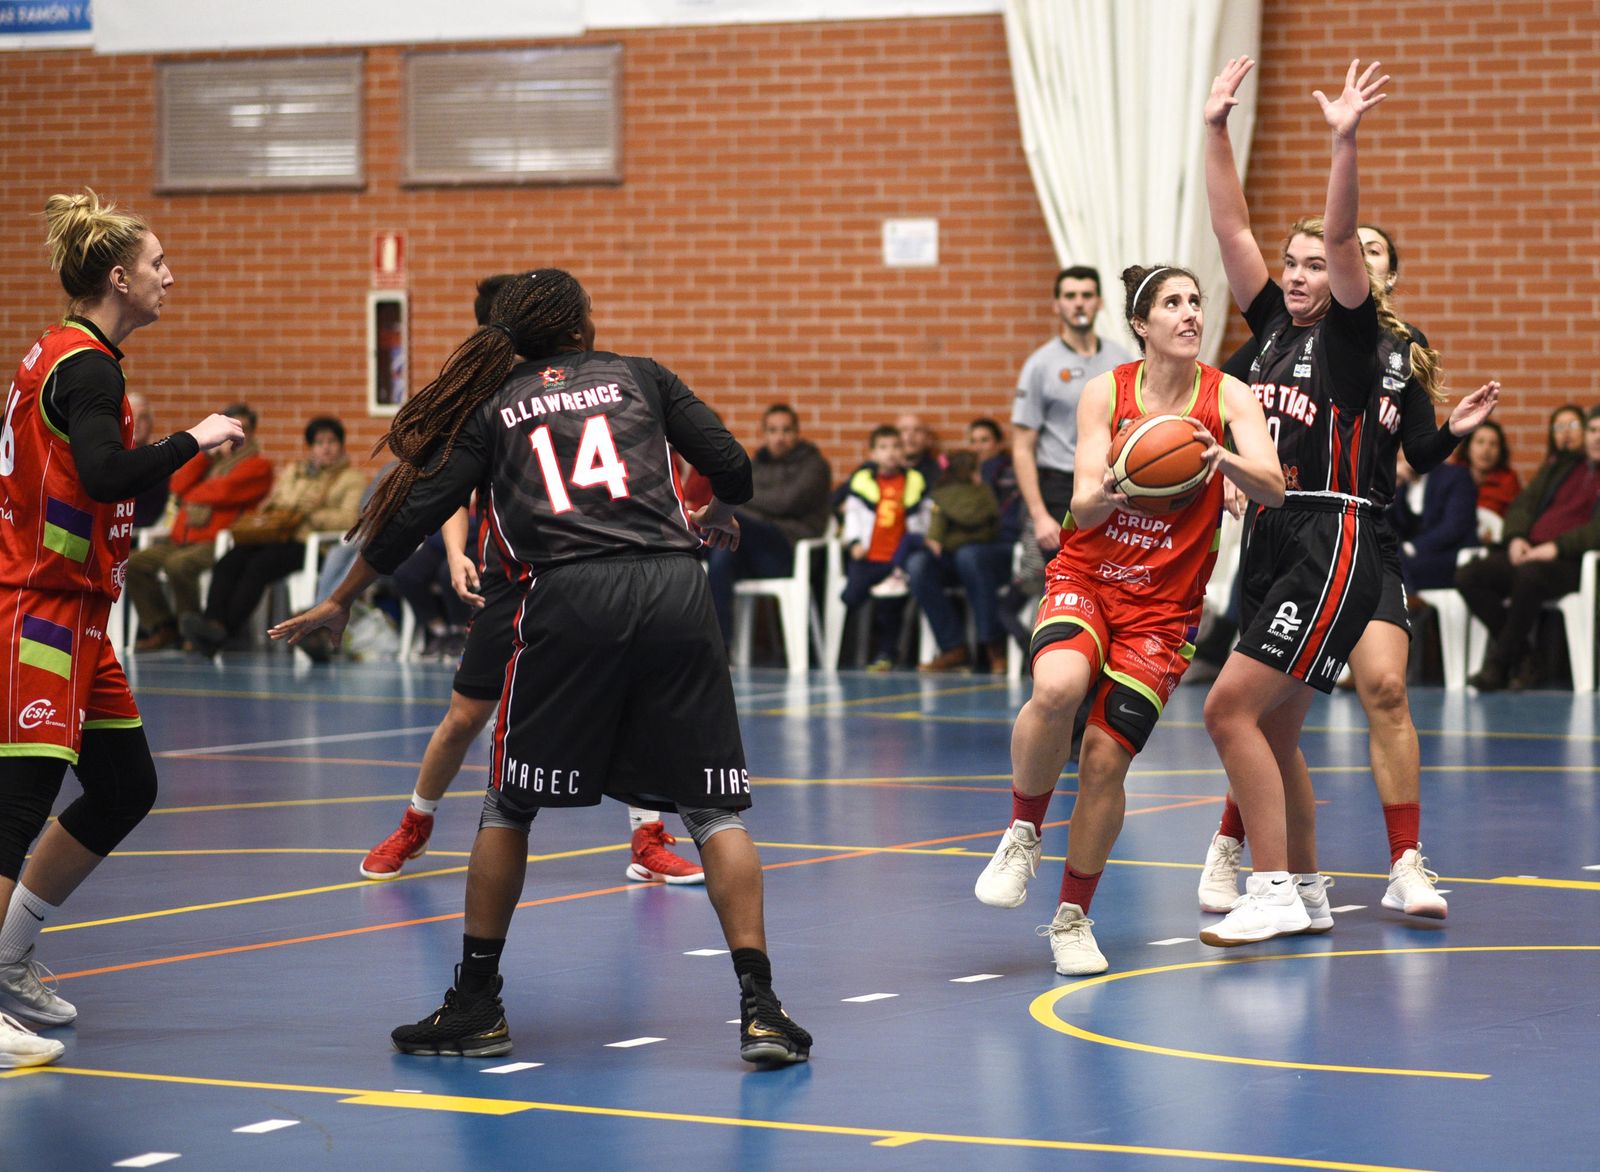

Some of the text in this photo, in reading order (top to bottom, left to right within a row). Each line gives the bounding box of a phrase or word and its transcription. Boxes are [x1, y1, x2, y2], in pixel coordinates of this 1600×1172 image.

[500, 383, 623, 429] D.LAWRENCE
[1278, 384, 1318, 428] TÍAS
[1379, 396, 1401, 435] ÍAS
[528, 412, 631, 516] 14
[506, 757, 751, 795] MAGEC TIAS
